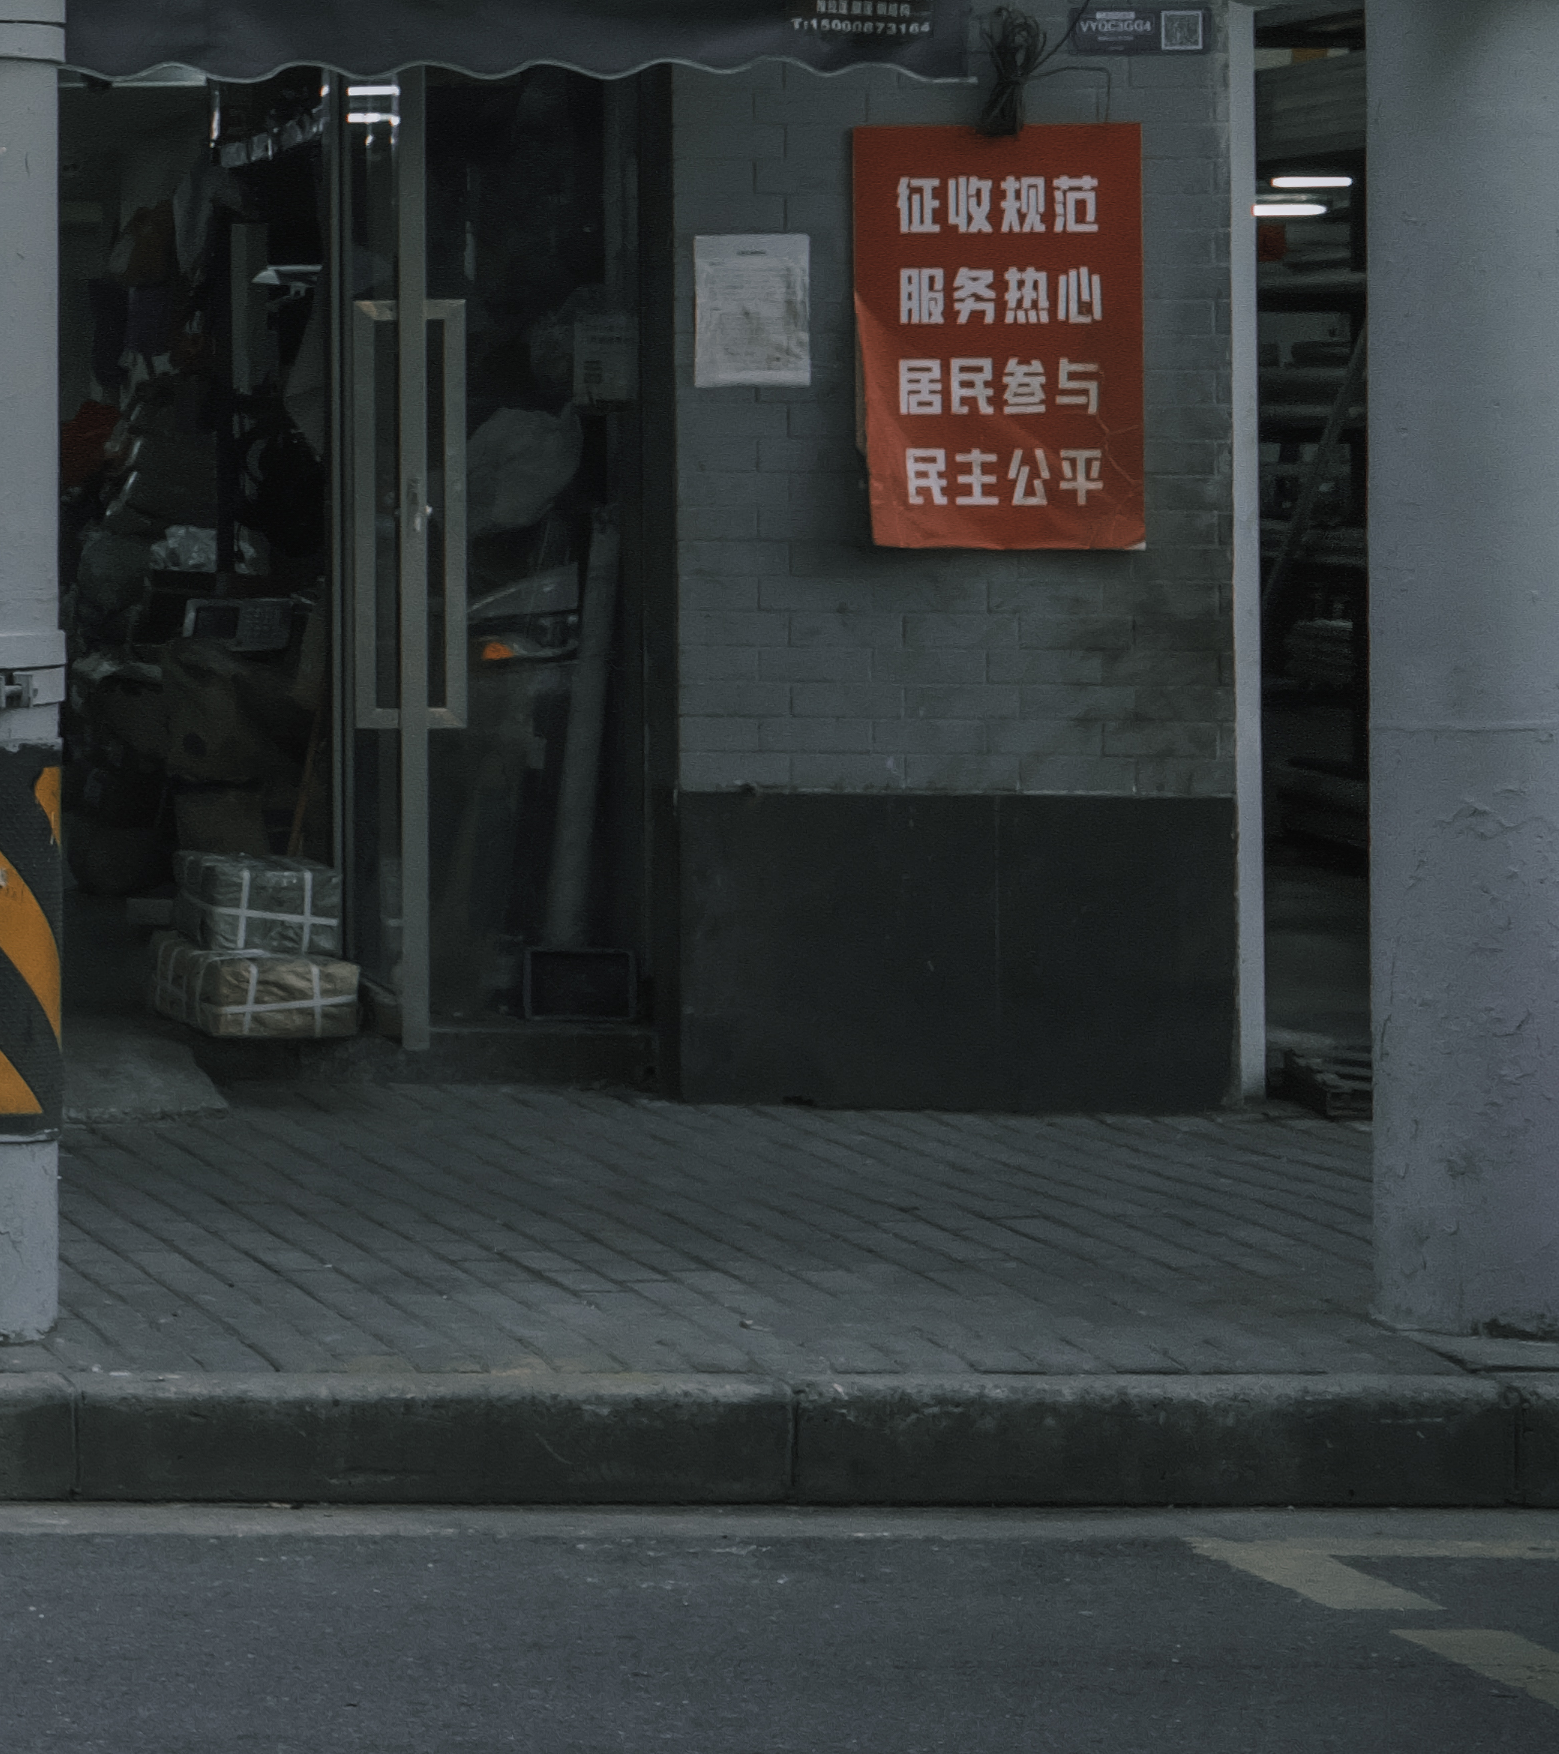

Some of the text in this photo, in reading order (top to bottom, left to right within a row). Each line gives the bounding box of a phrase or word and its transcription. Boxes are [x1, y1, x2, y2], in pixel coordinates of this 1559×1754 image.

[896, 175, 1099, 234] 征收规范
[898, 265, 1103, 325] 服务热心
[898, 357, 1101, 415] 居民参与
[905, 447, 1105, 506] 民主公平
